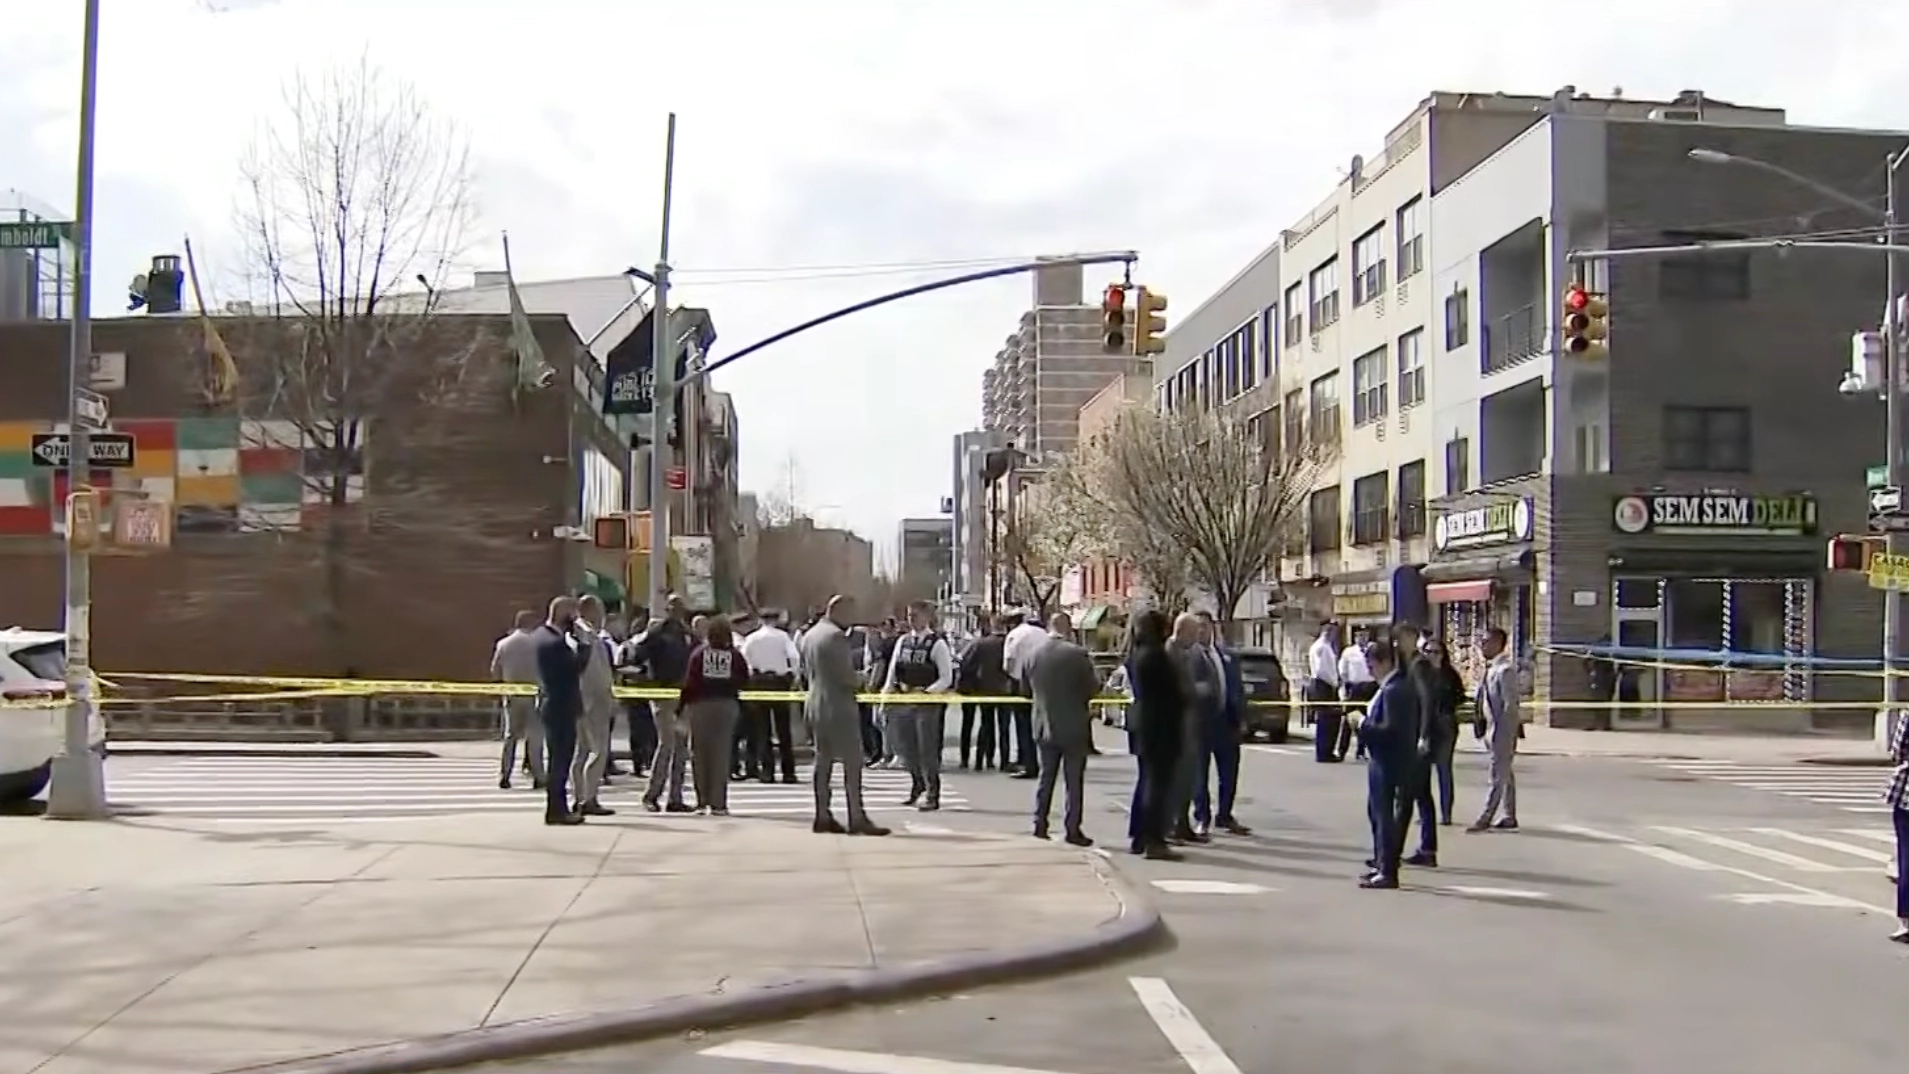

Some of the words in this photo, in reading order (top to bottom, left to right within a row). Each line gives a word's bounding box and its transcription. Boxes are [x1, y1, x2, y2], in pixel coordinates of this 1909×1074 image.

[93, 445, 125, 456] WAY
[1653, 497, 1700, 524] SEM
[1702, 497, 1749, 524] SEM
[1753, 497, 1802, 524] DELI
